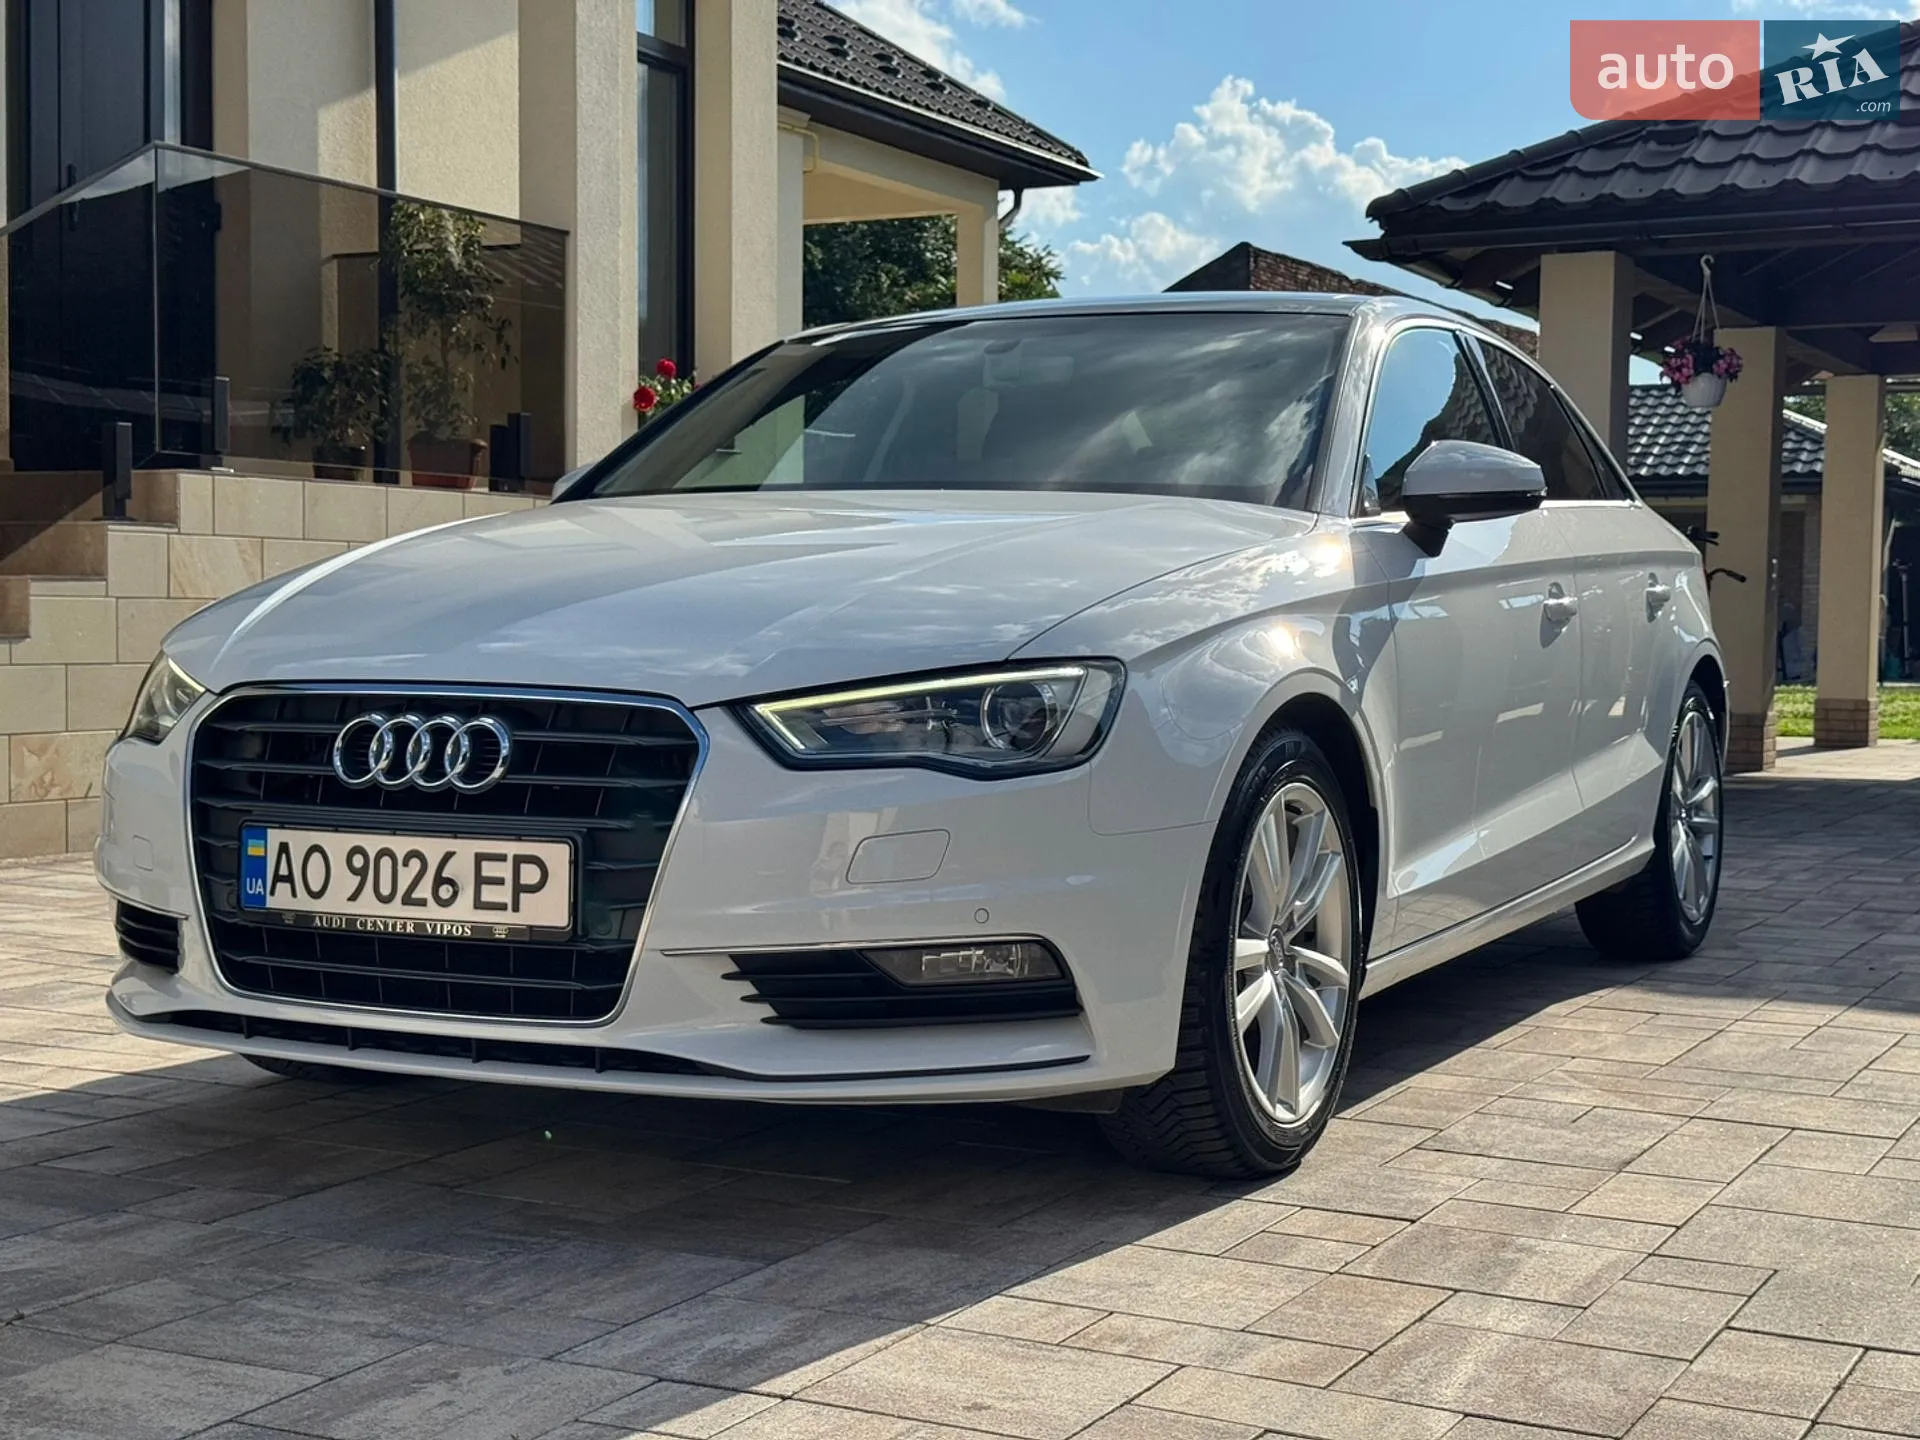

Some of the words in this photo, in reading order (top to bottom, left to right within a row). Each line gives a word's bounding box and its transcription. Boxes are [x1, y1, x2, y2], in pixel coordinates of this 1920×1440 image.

[246, 877, 264, 896] UA
[269, 841, 332, 900] AO
[345, 844, 460, 908] 9026
[473, 851, 550, 913] EP
[312, 915, 347, 929] AUDI
[356, 918, 416, 934] CENTER
[426, 923, 473, 937] VIPOS
